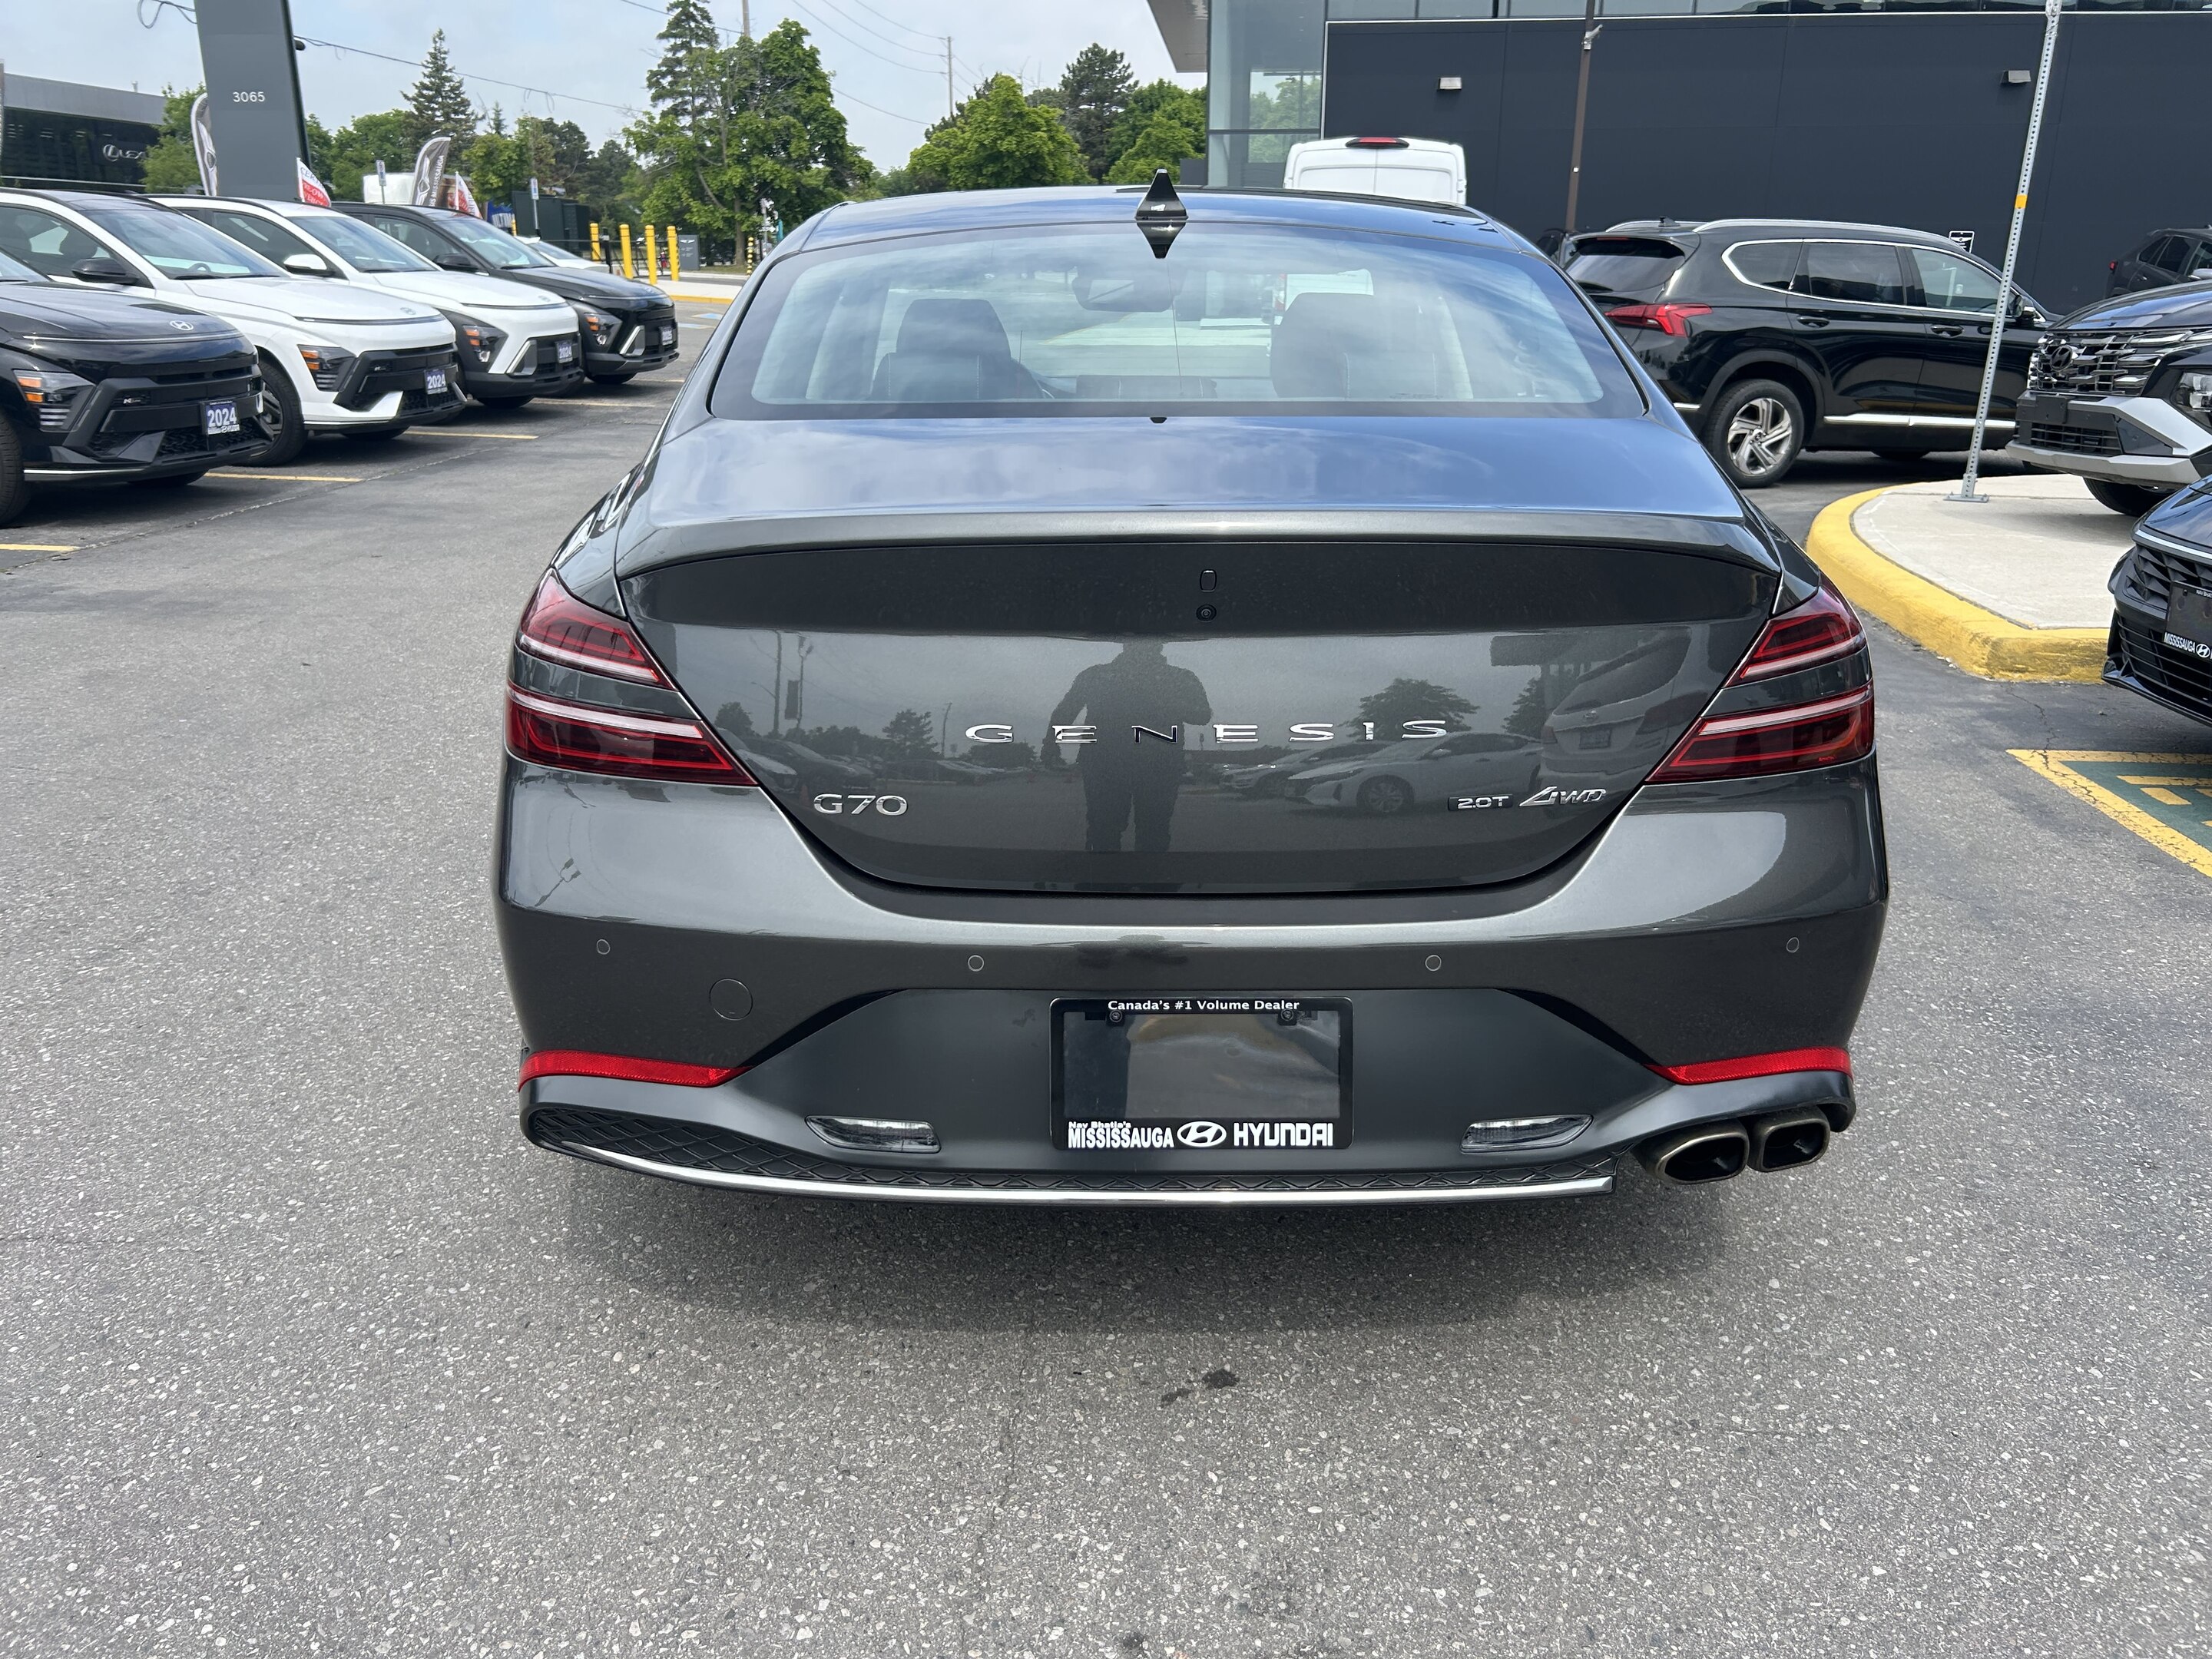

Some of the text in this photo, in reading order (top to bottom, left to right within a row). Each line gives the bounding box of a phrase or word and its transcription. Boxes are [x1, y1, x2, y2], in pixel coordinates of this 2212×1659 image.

[233, 91, 266, 102] 3065
[427, 374, 446, 389] 2024
[207, 407, 237, 428] 2024
[2164, 632, 2196, 653] MISSISSAUGA
[965, 719, 1448, 745] GENESIS
[814, 793, 908, 816] G70
[1458, 796, 1509, 810] 2.0T
[1108, 1000, 1300, 1010] Canada's #1 Volume Dealer
[1068, 1122, 1333, 1148] MISSISSAUGA HYUNDAI
